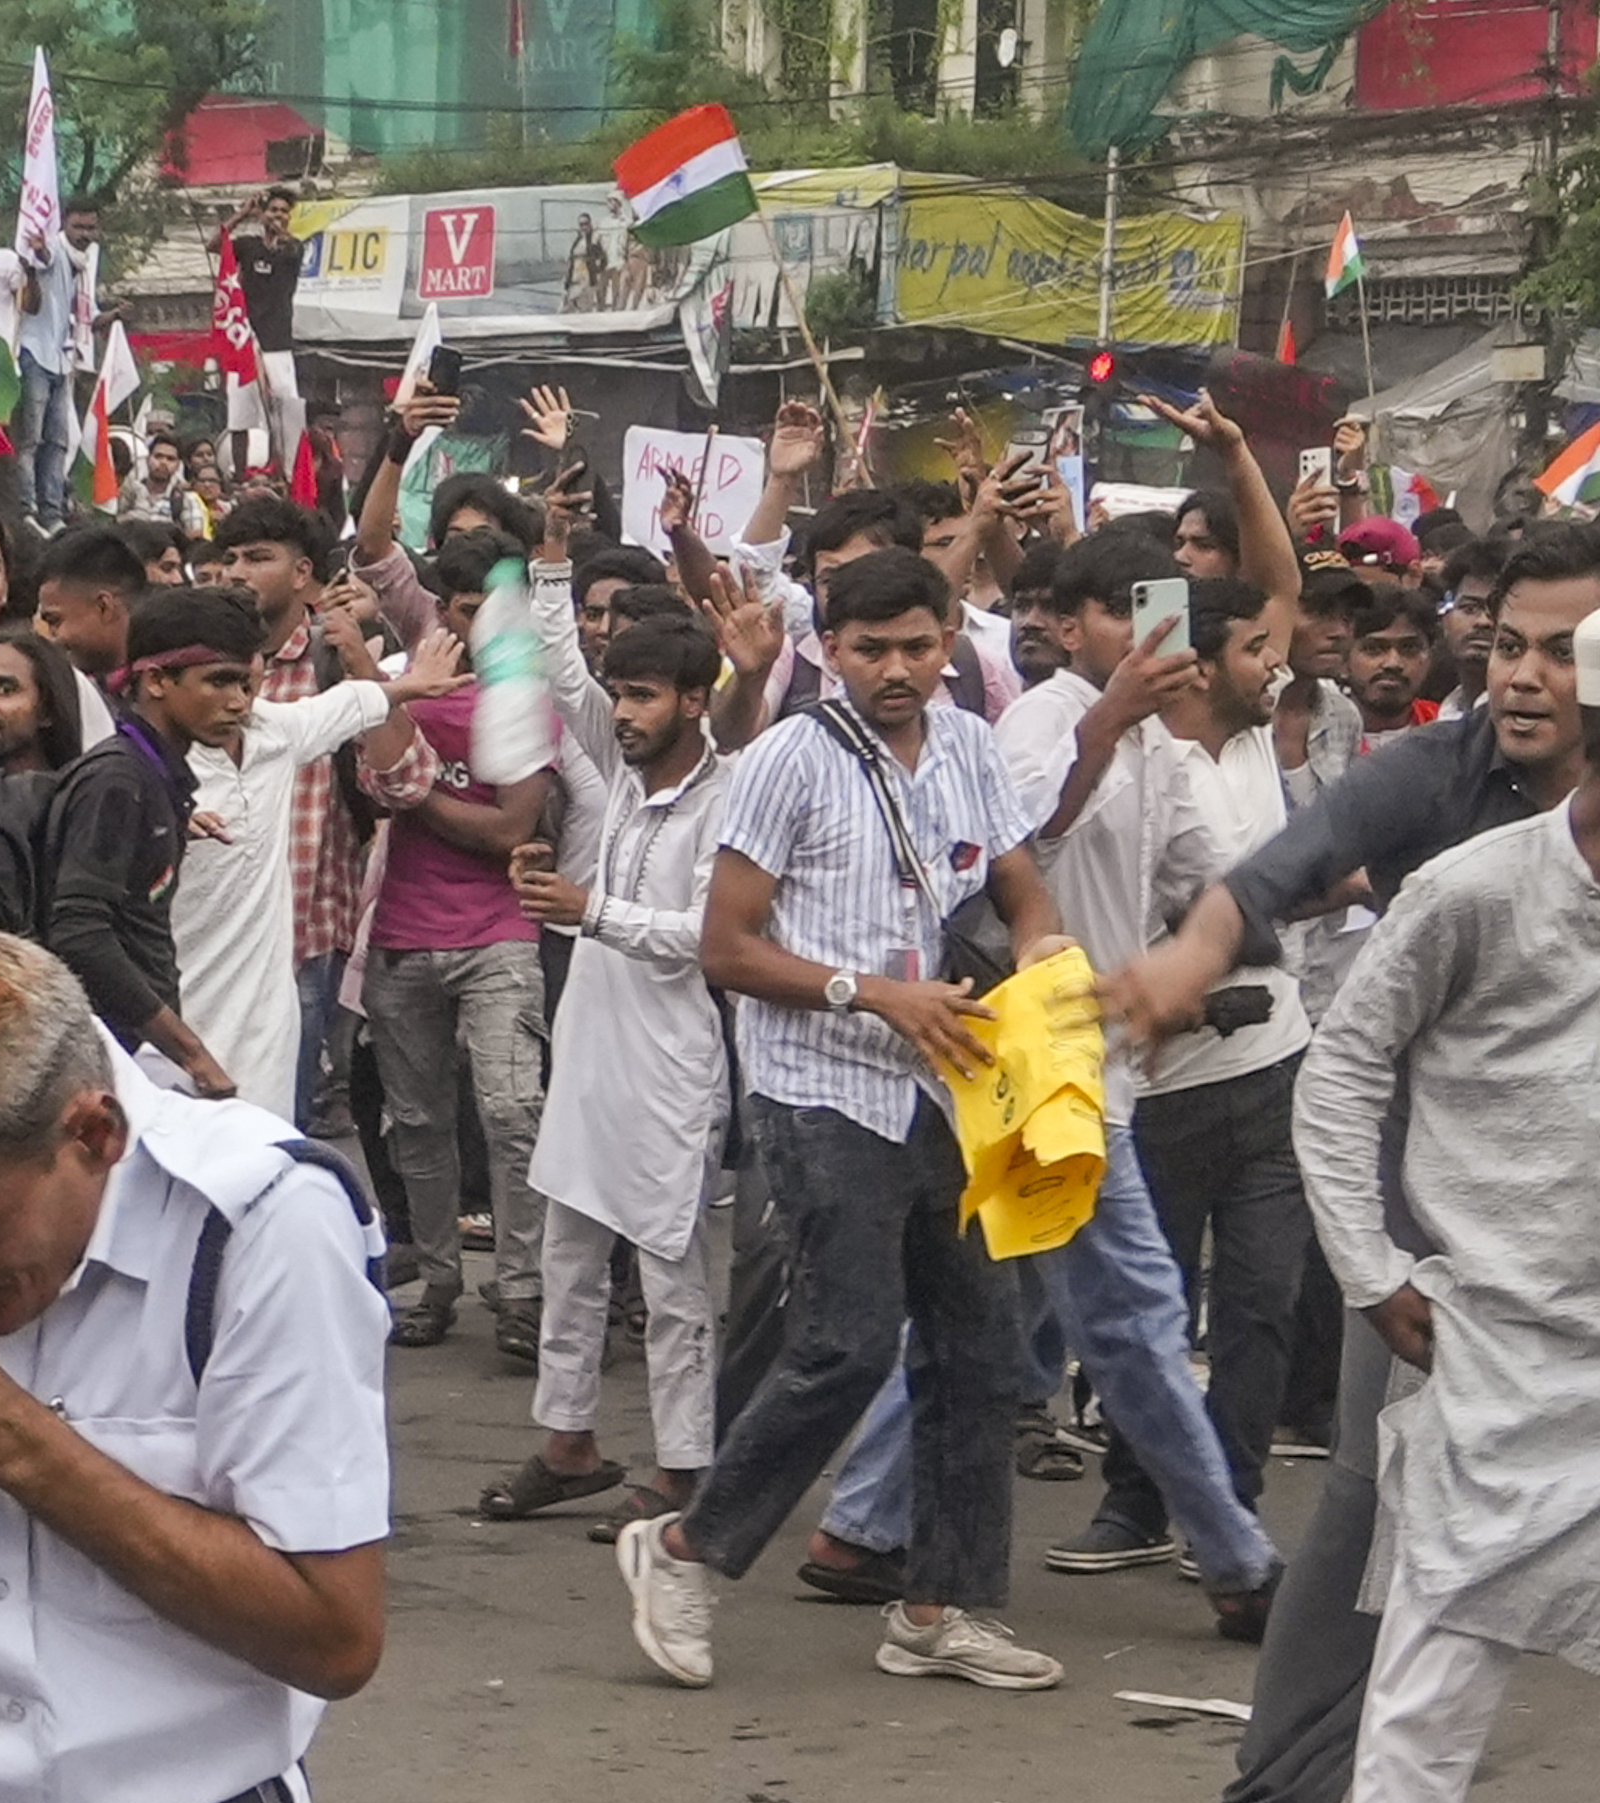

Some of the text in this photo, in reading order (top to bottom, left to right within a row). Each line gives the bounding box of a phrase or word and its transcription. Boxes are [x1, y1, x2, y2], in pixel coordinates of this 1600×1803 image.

[327, 232, 380, 271] LIC
[440, 213, 479, 265] V
[425, 266, 486, 293] MART
